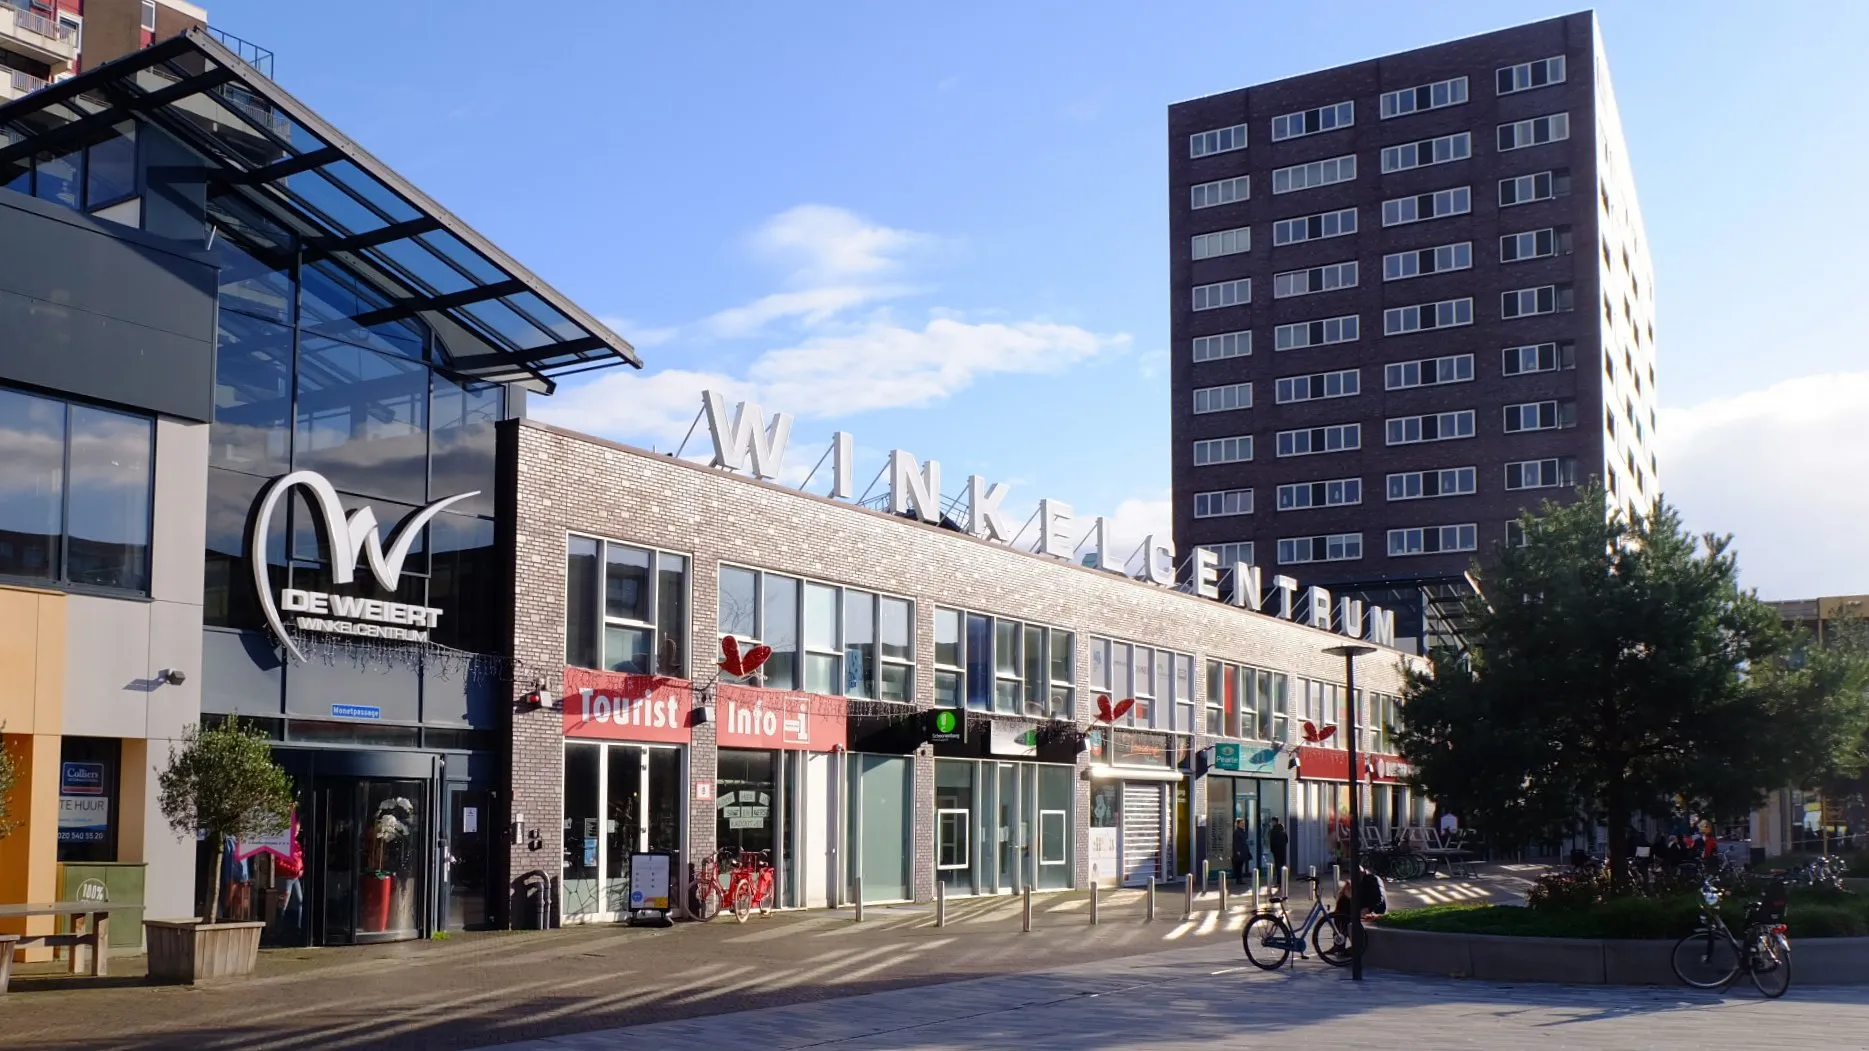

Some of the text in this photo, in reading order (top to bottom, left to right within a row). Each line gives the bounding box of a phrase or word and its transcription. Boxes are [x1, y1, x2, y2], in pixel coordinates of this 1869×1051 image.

[702, 389, 1395, 649] WINKELCENTRUM
[281, 588, 443, 628] DE WEIERT
[296, 616, 428, 643] WINKELCENTRUM
[578, 687, 678, 730] Tourist
[727, 699, 777, 737] Info
[66, 767, 99, 779] Colliers
[60, 800, 105, 811] TE HUUR
[82, 884, 103, 900] 100%
